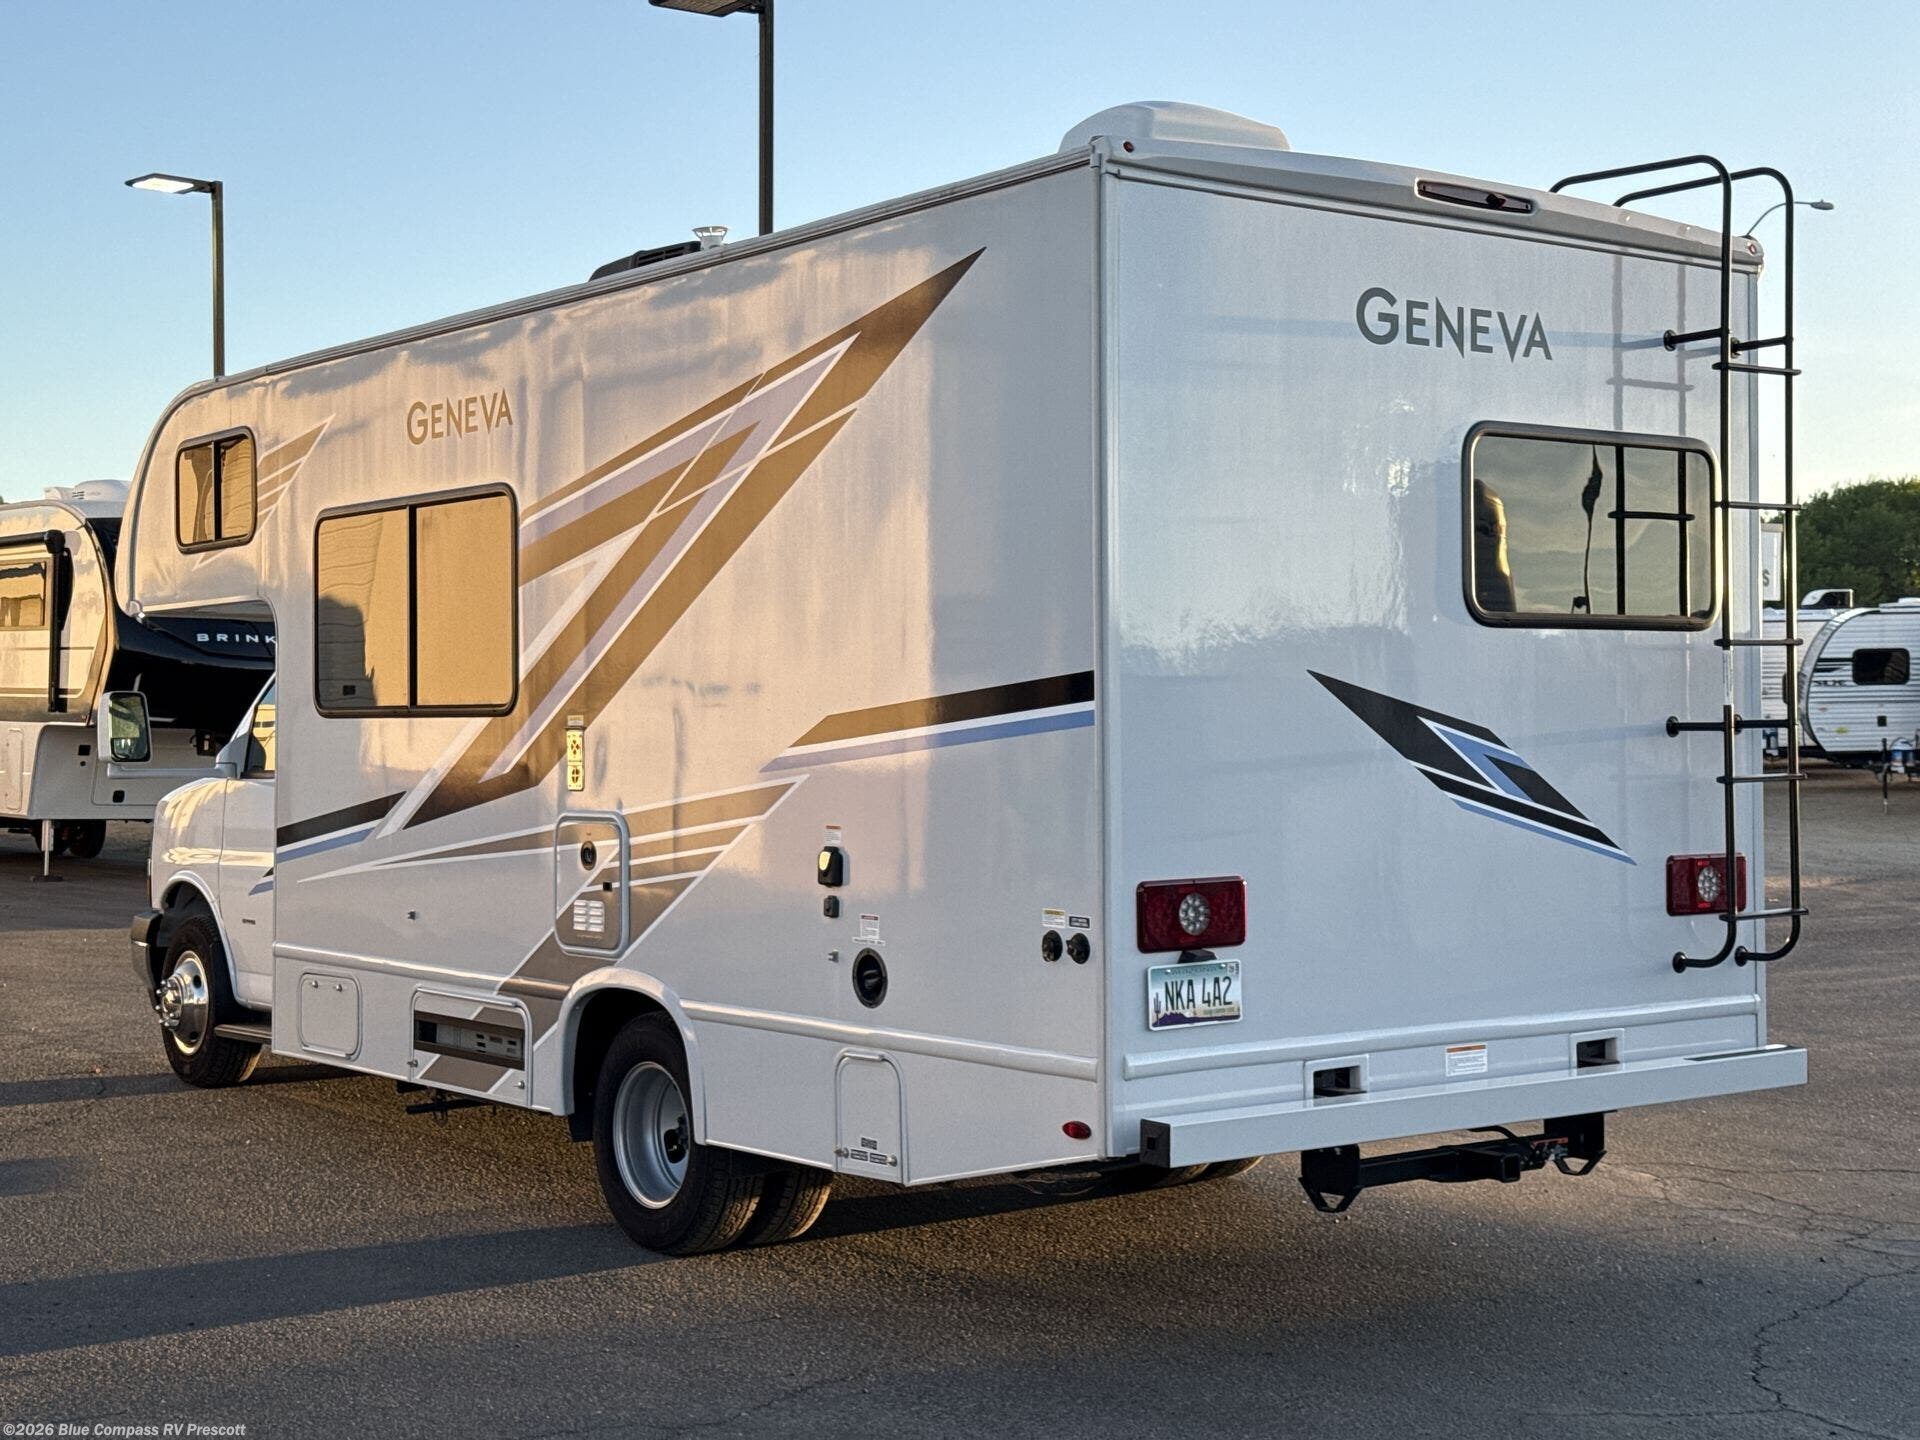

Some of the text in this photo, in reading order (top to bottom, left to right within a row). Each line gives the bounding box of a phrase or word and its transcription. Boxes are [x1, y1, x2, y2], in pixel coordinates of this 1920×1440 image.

[1356, 287, 1553, 363] GENEVA
[407, 387, 513, 445] GENEVA
[1164, 976, 1233, 1012] NKA 4A2
